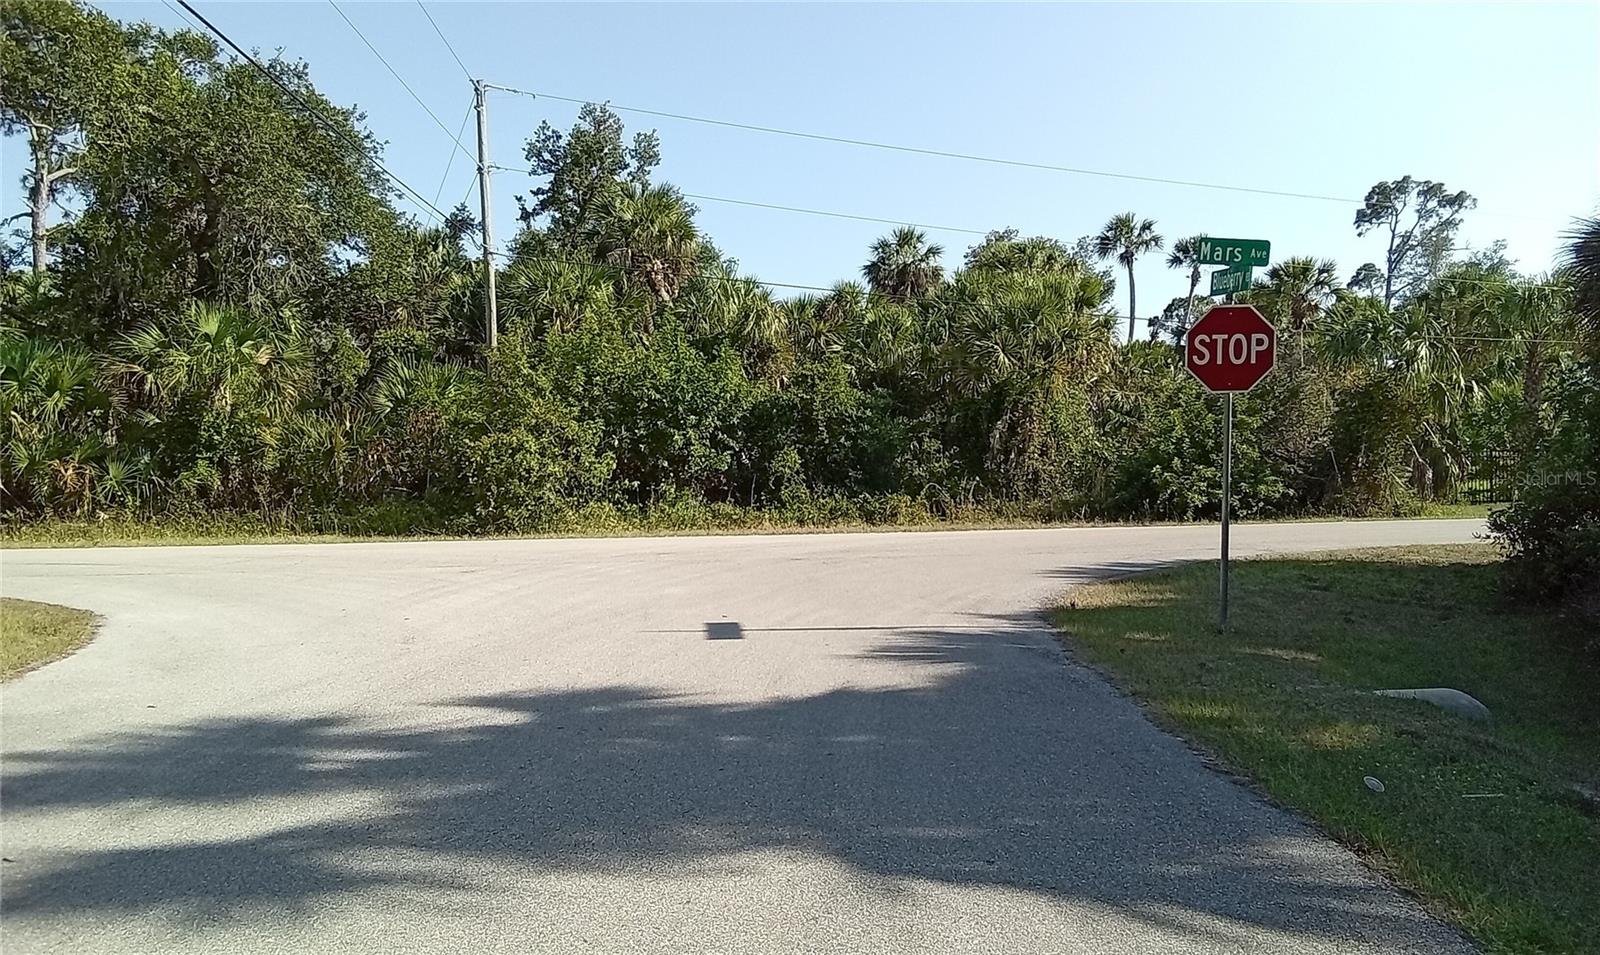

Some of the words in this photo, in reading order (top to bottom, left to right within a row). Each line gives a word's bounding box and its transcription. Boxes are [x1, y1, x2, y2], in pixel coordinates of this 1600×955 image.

[1200, 241, 1242, 261] Mars
[1250, 248, 1267, 258] Ave
[1192, 333, 1269, 365] STOP
